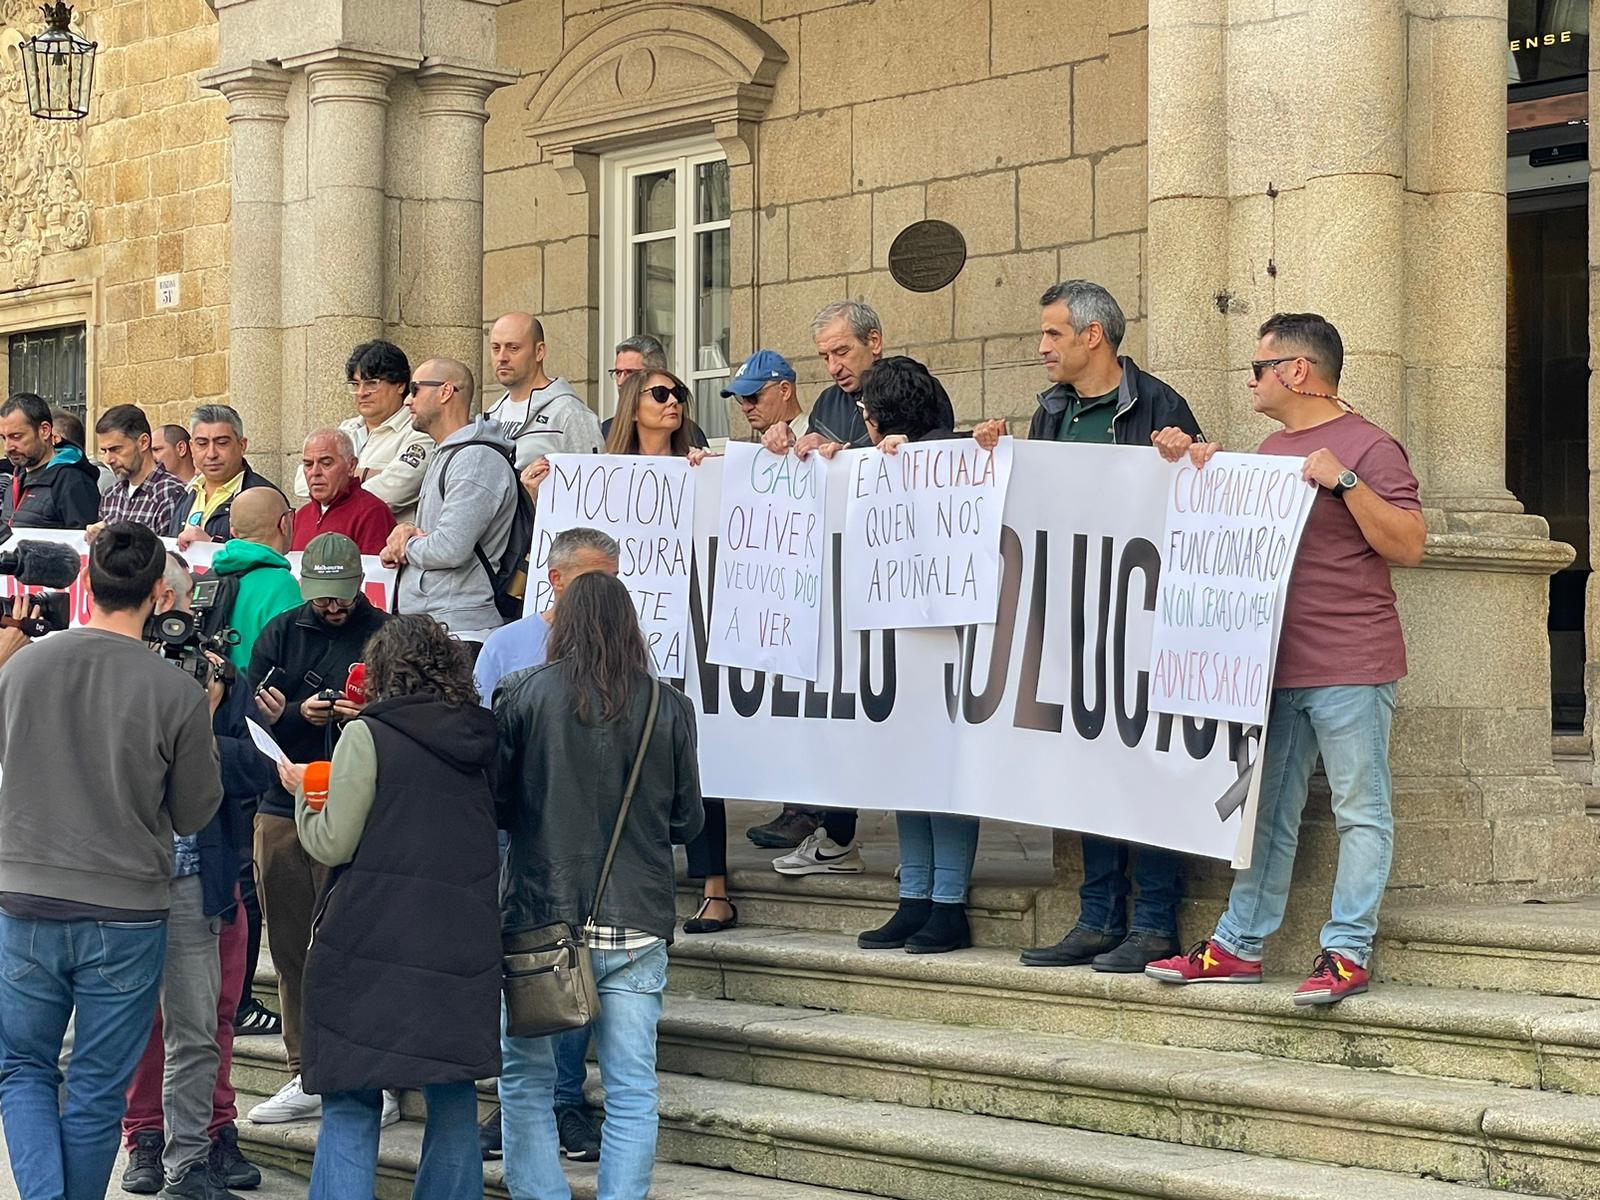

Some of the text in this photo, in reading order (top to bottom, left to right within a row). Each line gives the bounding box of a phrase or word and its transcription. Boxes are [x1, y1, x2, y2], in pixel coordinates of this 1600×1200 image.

[750, 446, 817, 500] GAGO
[902, 448, 996, 492] OFICIALA
[1174, 462, 1298, 522] COMPAÑEIRO
[727, 503, 817, 559] OLIVER
[865, 494, 984, 548] QUEN NOS
[723, 560, 786, 601] VEUVOS
[867, 552, 978, 603] APUÑALA
[1168, 525, 1287, 582] FUNCIONARIO
[725, 606, 792, 648] A VER
[1163, 582, 1196, 628] NON
[1249, 591, 1275, 632] MEU
[1152, 648, 1263, 708] ADVERSARIO
